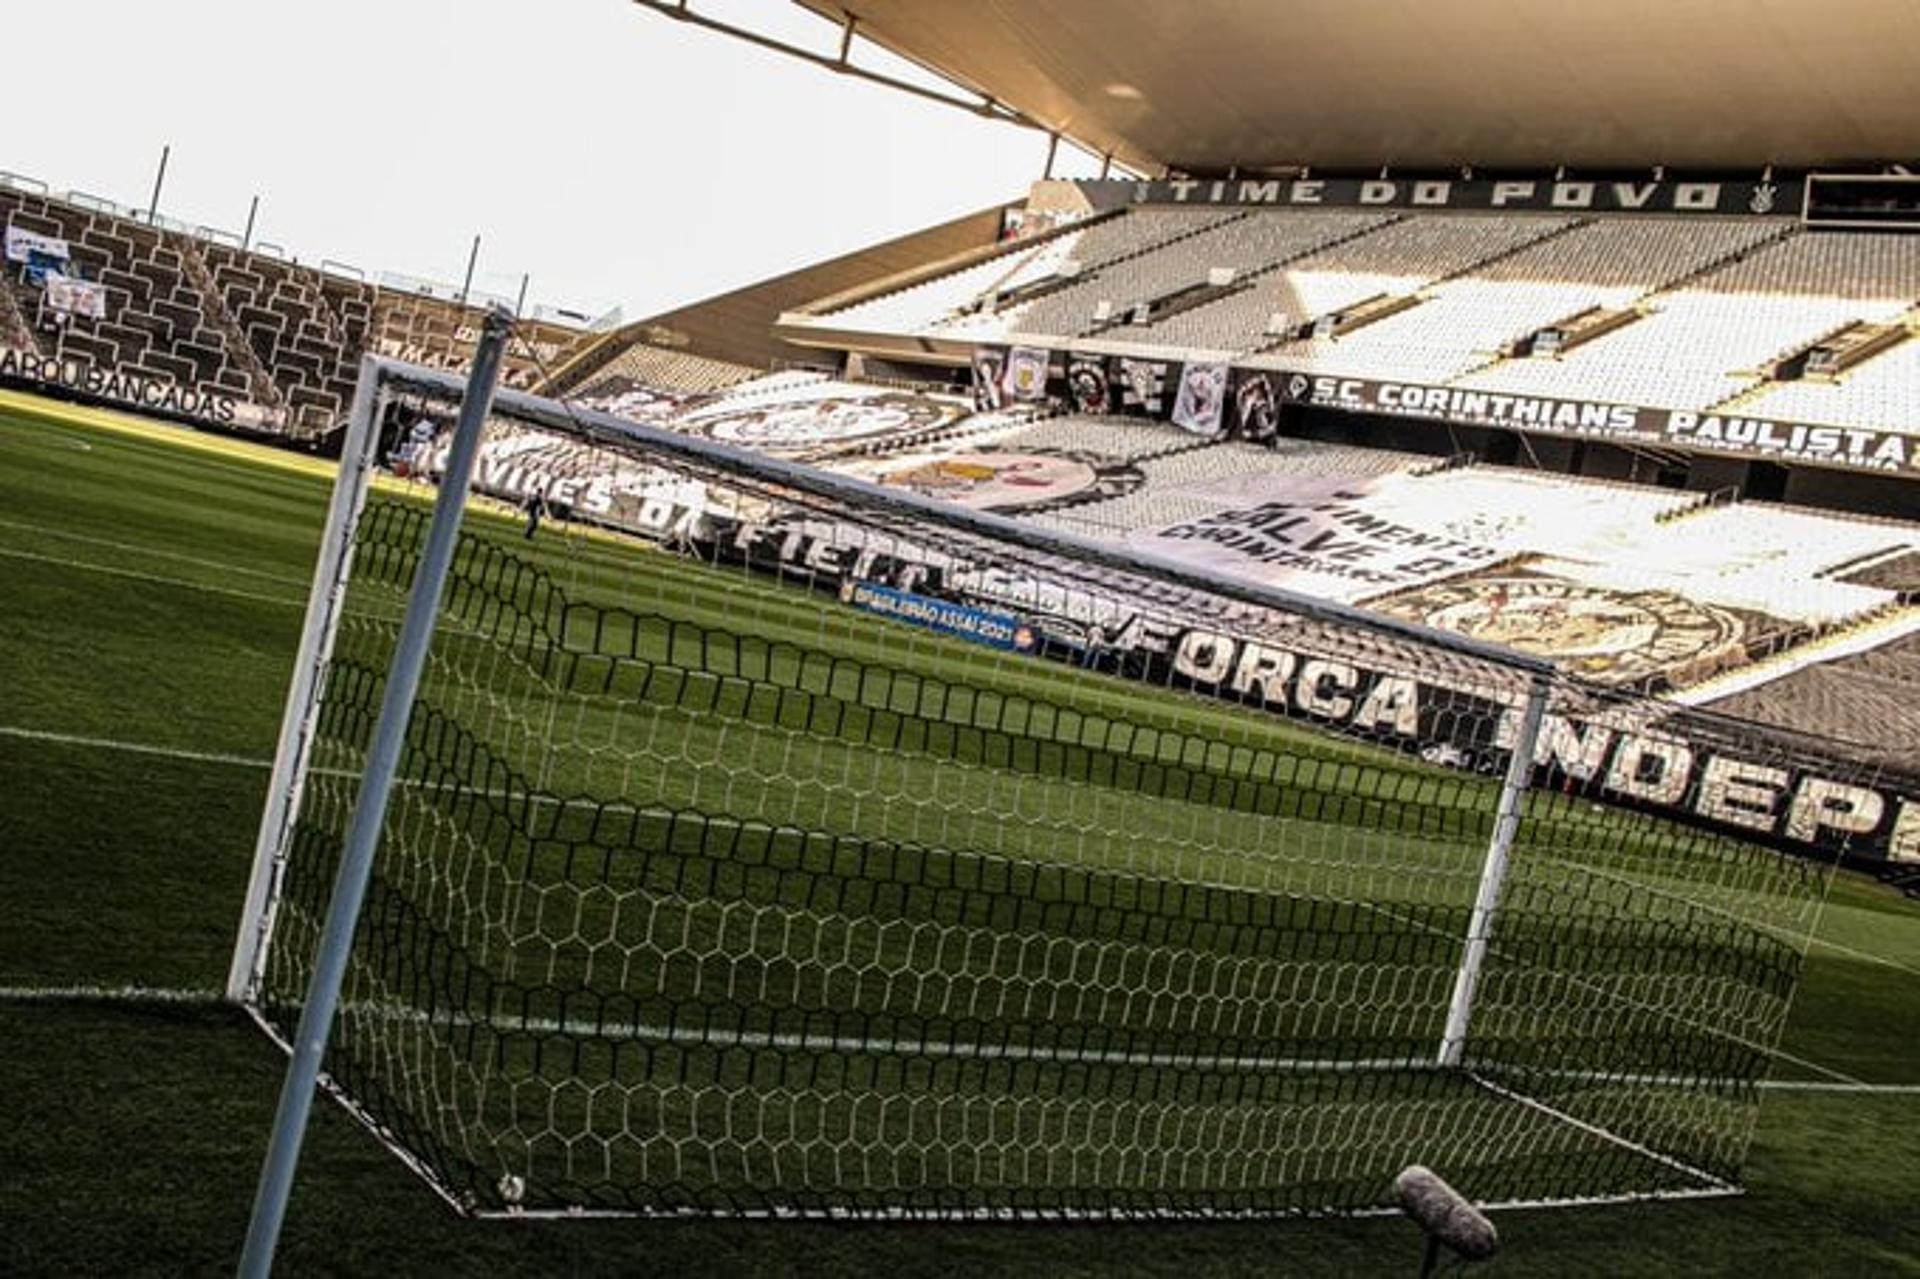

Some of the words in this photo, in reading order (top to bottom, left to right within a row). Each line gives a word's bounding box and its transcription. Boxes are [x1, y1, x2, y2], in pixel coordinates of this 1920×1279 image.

[1169, 180, 1325, 202] TIME
[1360, 180, 1451, 204] DO
[1491, 181, 1721, 209] POVO
[1377, 383, 1639, 429] CORINTHIANS
[1667, 410, 1905, 463] PAULISTA
